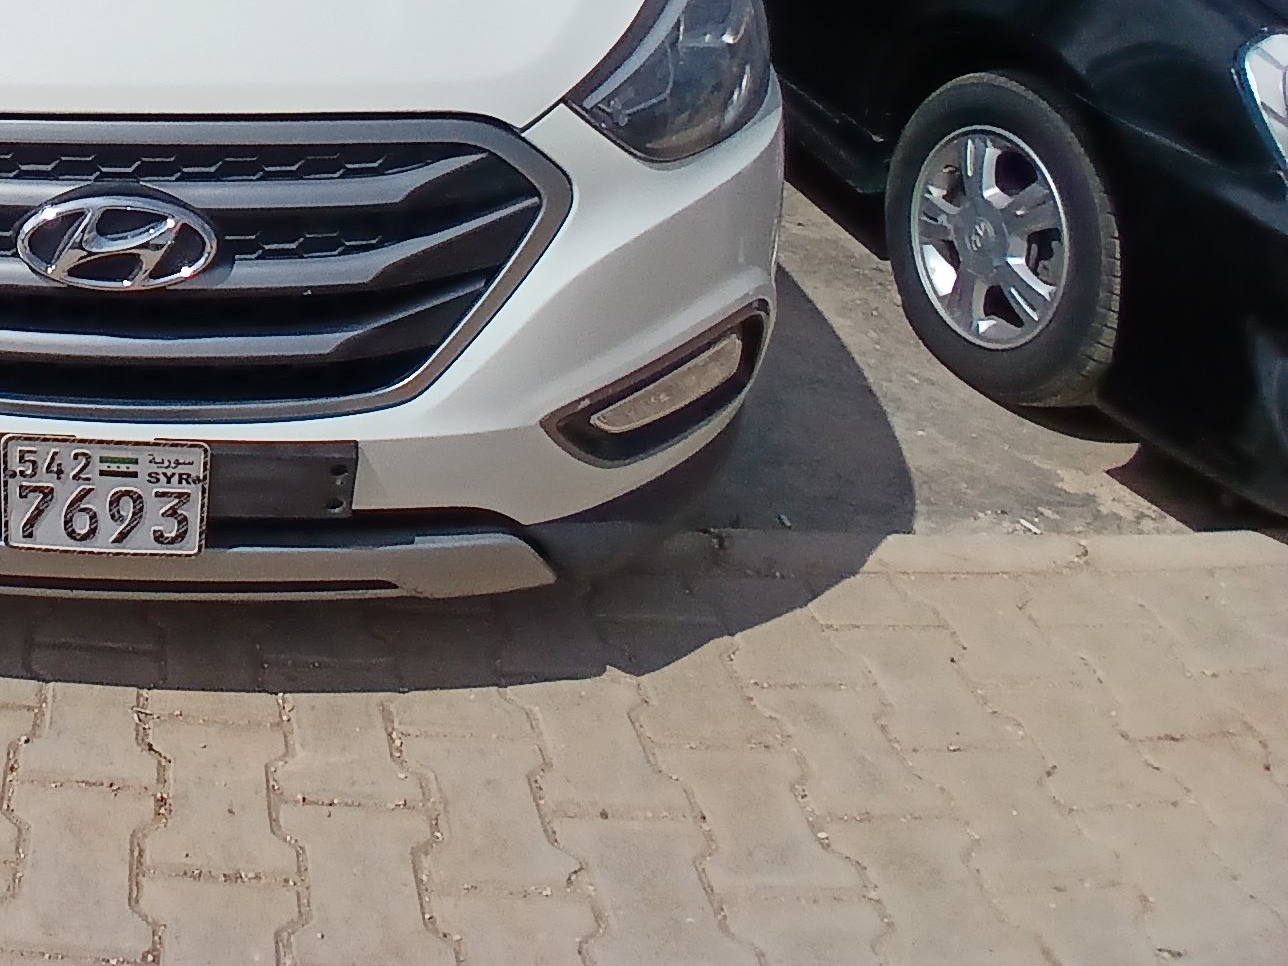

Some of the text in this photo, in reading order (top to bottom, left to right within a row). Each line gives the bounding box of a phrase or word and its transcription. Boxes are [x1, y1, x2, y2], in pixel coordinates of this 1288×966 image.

[16, 447, 92, 481] 542
[147, 453, 195, 469] سورية
[146, 471, 193, 485] SYR
[16, 482, 192, 546] 7693
